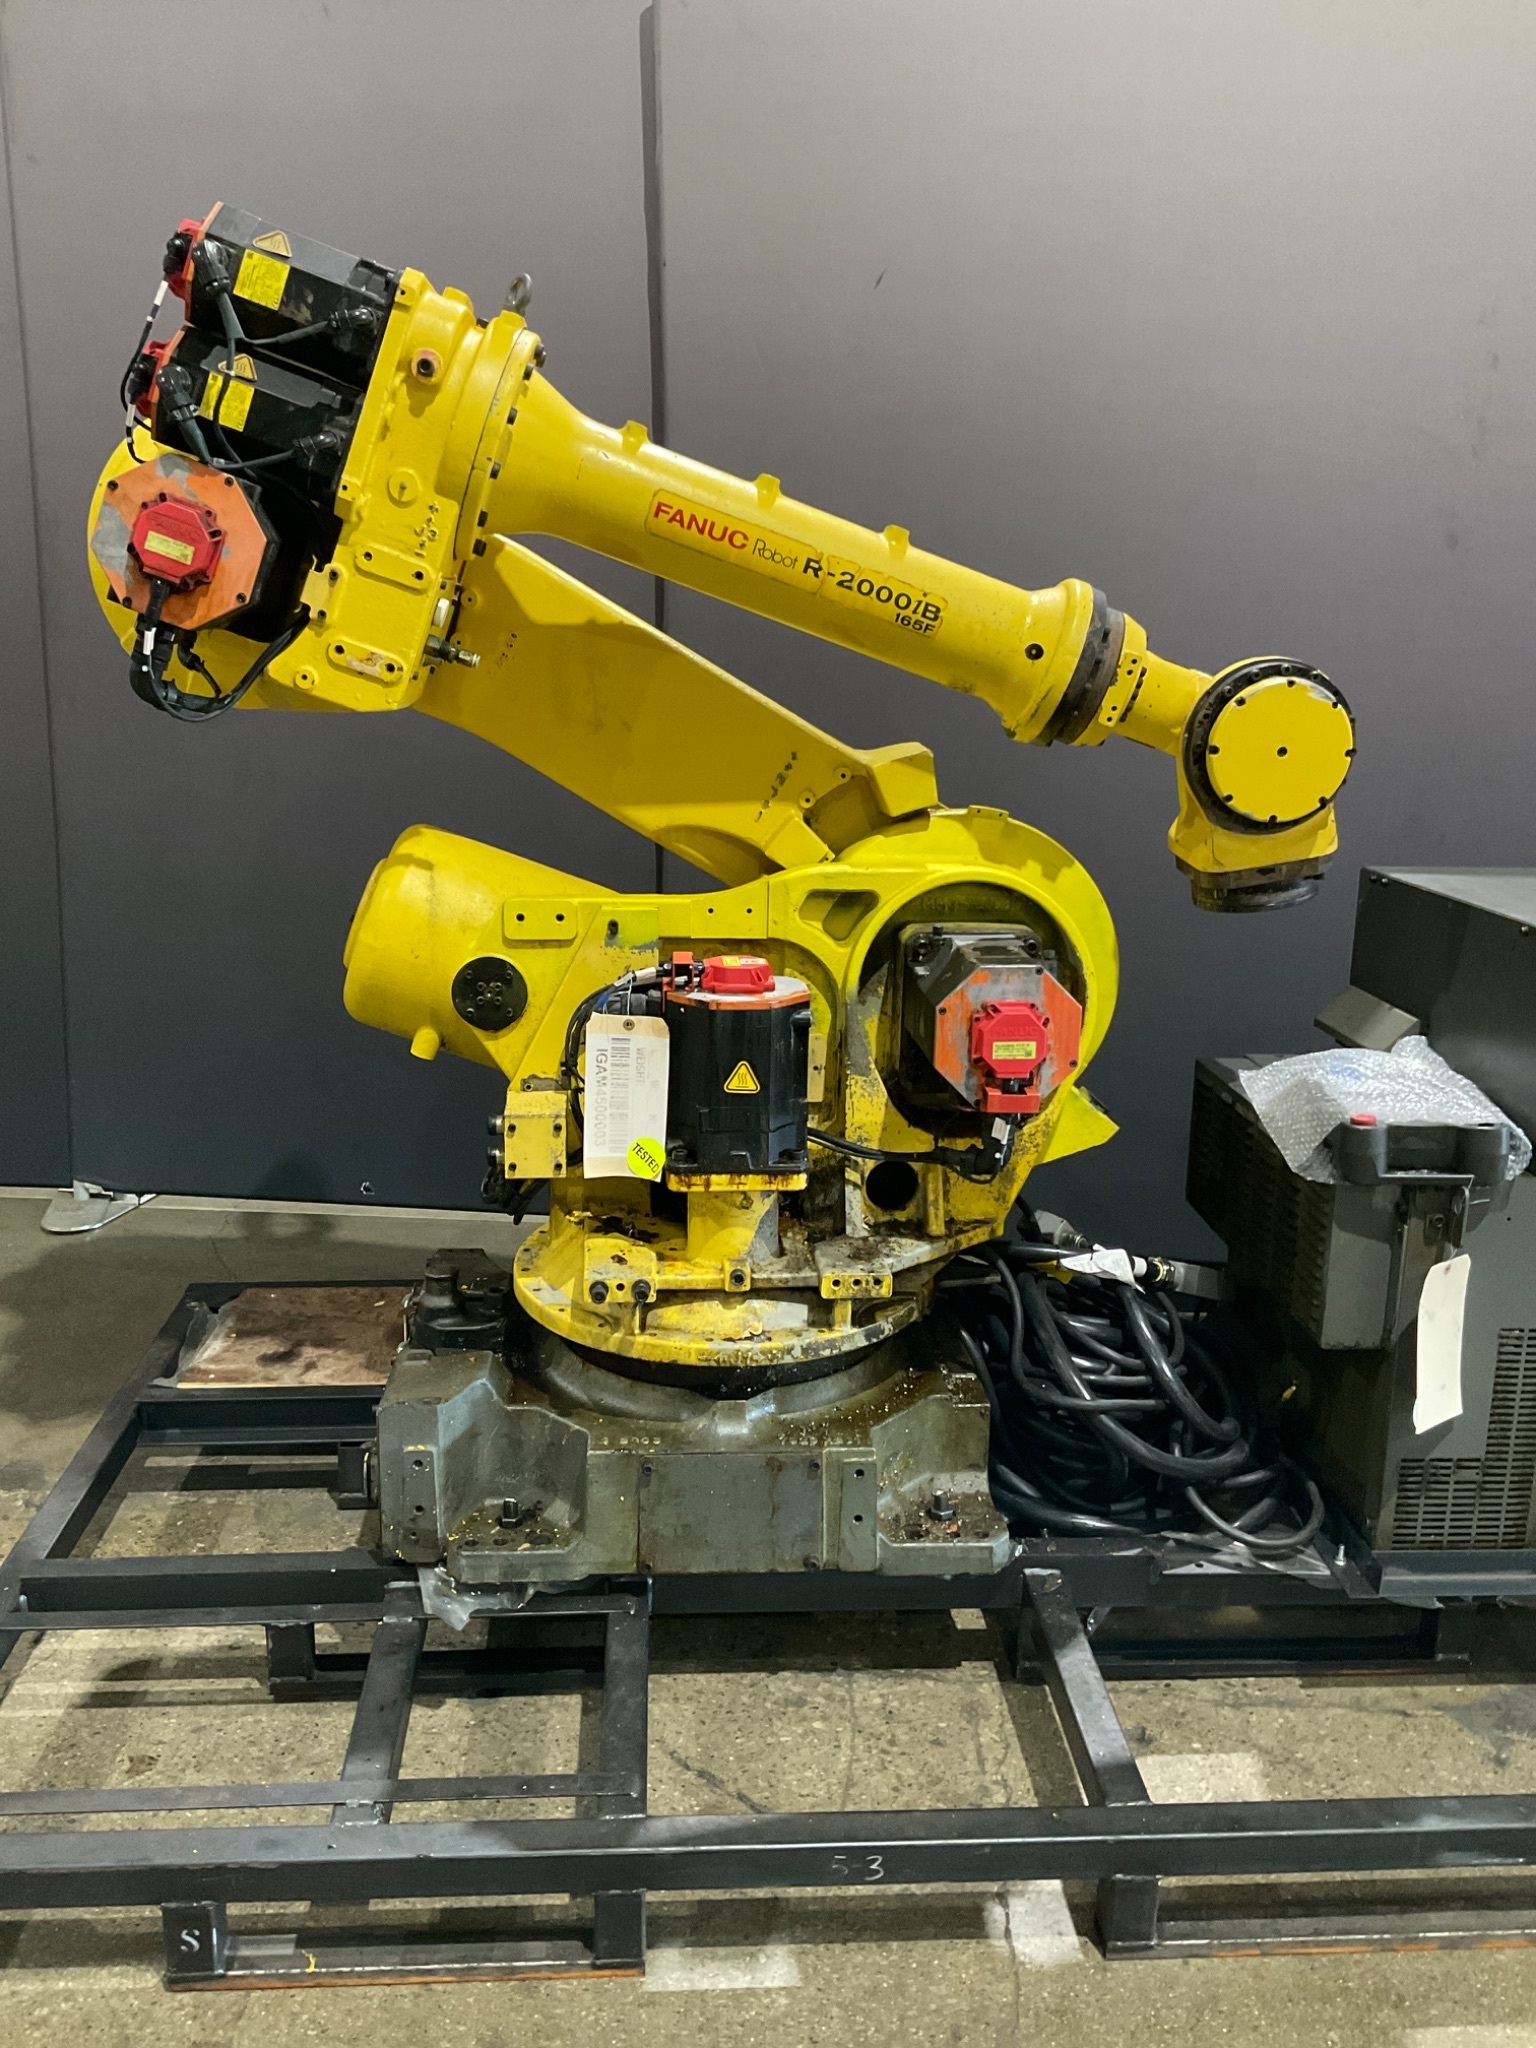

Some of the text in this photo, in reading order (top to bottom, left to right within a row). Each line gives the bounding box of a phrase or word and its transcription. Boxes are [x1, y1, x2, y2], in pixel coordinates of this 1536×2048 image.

[653, 501, 749, 550] FANUC
[752, 537, 800, 570] Robot
[894, 613, 936, 635] 165F
[632, 1142, 660, 1173] TESTED
